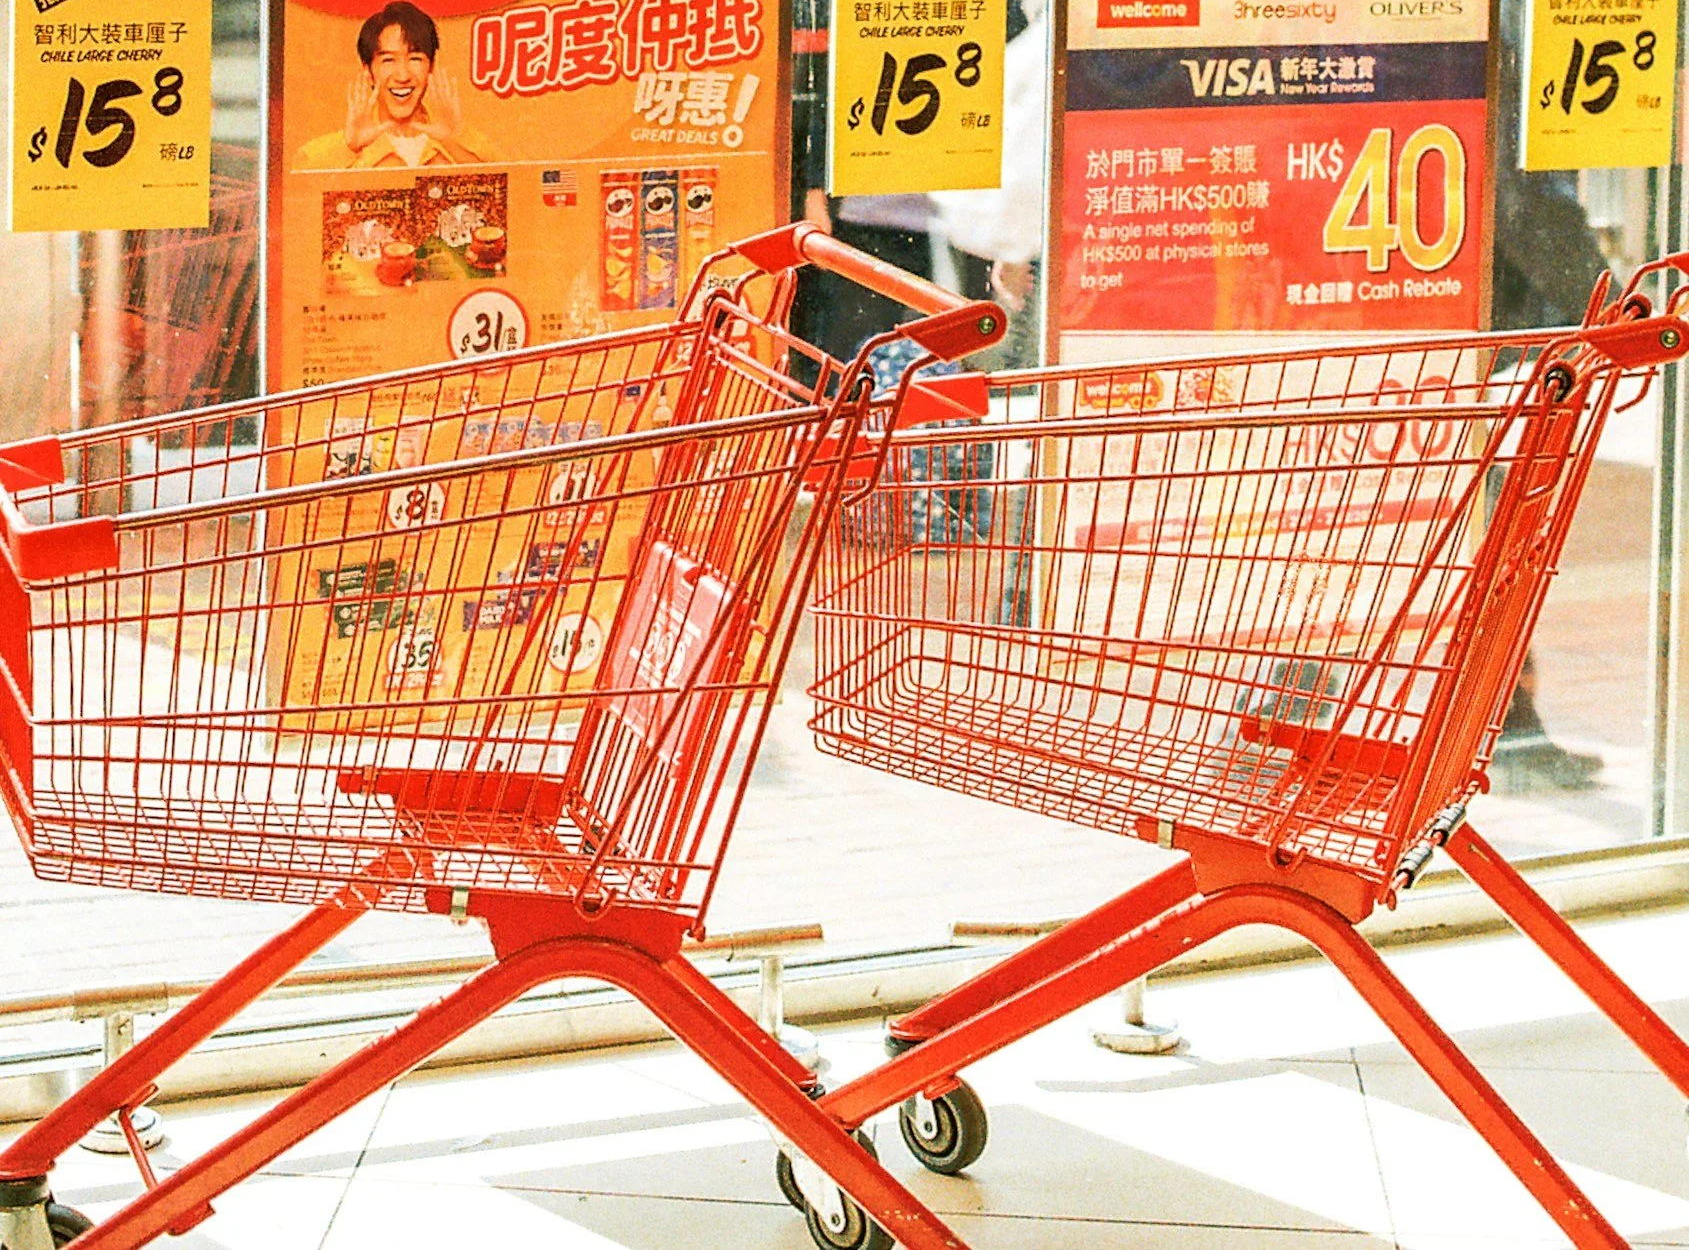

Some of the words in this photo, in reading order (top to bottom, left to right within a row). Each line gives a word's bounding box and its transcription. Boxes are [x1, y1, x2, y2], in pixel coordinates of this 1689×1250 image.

[854, 0, 986, 21] 智利大裝車厘子
[1110, 0, 1188, 18] wellcome
[1234, 0, 1337, 24] 3hreesixty
[1369, 0, 1464, 16] OLIVER'S
[34, 22, 188, 45] 智利大裝車厘子
[859, 26, 889, 38] CHILE
[891, 25, 923, 38] LARGE
[925, 24, 965, 37] CHERRY
[40, 50, 75, 63] CHILE
[77, 50, 115, 63] LARGE
[117, 49, 163, 63] CHERRY
[1179, 58, 1276, 98] VISA
[1279, 83, 1304, 95] New
[1305, 82, 1329, 95] Year
[1330, 81, 1375, 94] Rewards
[630, 128, 675, 142] GREAT
[676, 129, 719, 146] DEALS
[1085, 145, 1257, 179] 於門市單一簽賬
[1082, 224, 1096, 239] A
[1099, 222, 1142, 242] single
[1145, 222, 1169, 237] net
[1172, 219, 1237, 239] spending
[1240, 216, 1255, 233] of
[1082, 244, 1142, 262] HK$500
[1145, 245, 1160, 260] at
[1163, 242, 1221, 262] physical
[1225, 241, 1270, 257] stores
[1080, 274, 1096, 289] to
[1099, 271, 1123, 291] get
[1357, 281, 1400, 301] Cash
[1403, 277, 1462, 298] Rebate
